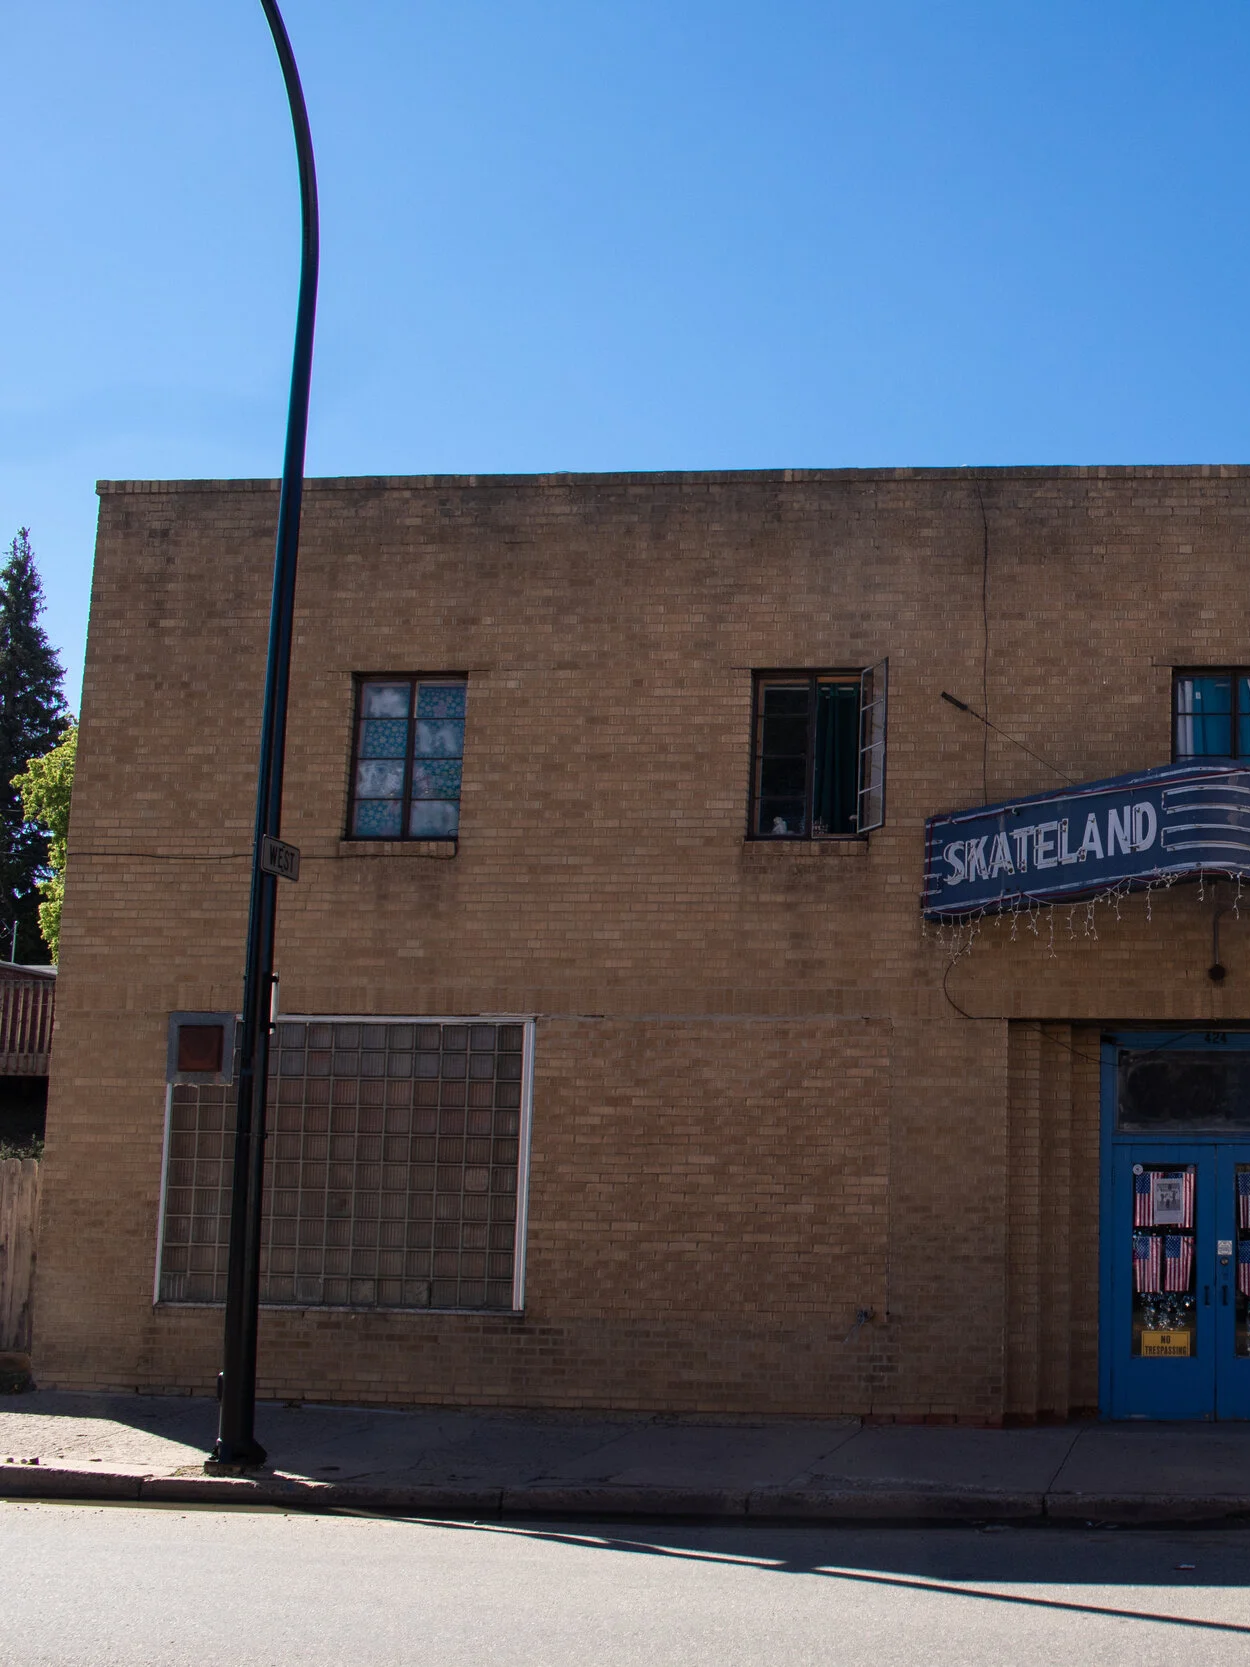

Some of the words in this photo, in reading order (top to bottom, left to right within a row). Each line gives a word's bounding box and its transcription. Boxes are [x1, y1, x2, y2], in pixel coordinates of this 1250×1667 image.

[943, 801, 1158, 886] SKATELAND
[270, 844, 295, 873] WEST
[1160, 1335, 1171, 1344] NO
[1145, 1346, 1186, 1355] TRESPASSING
